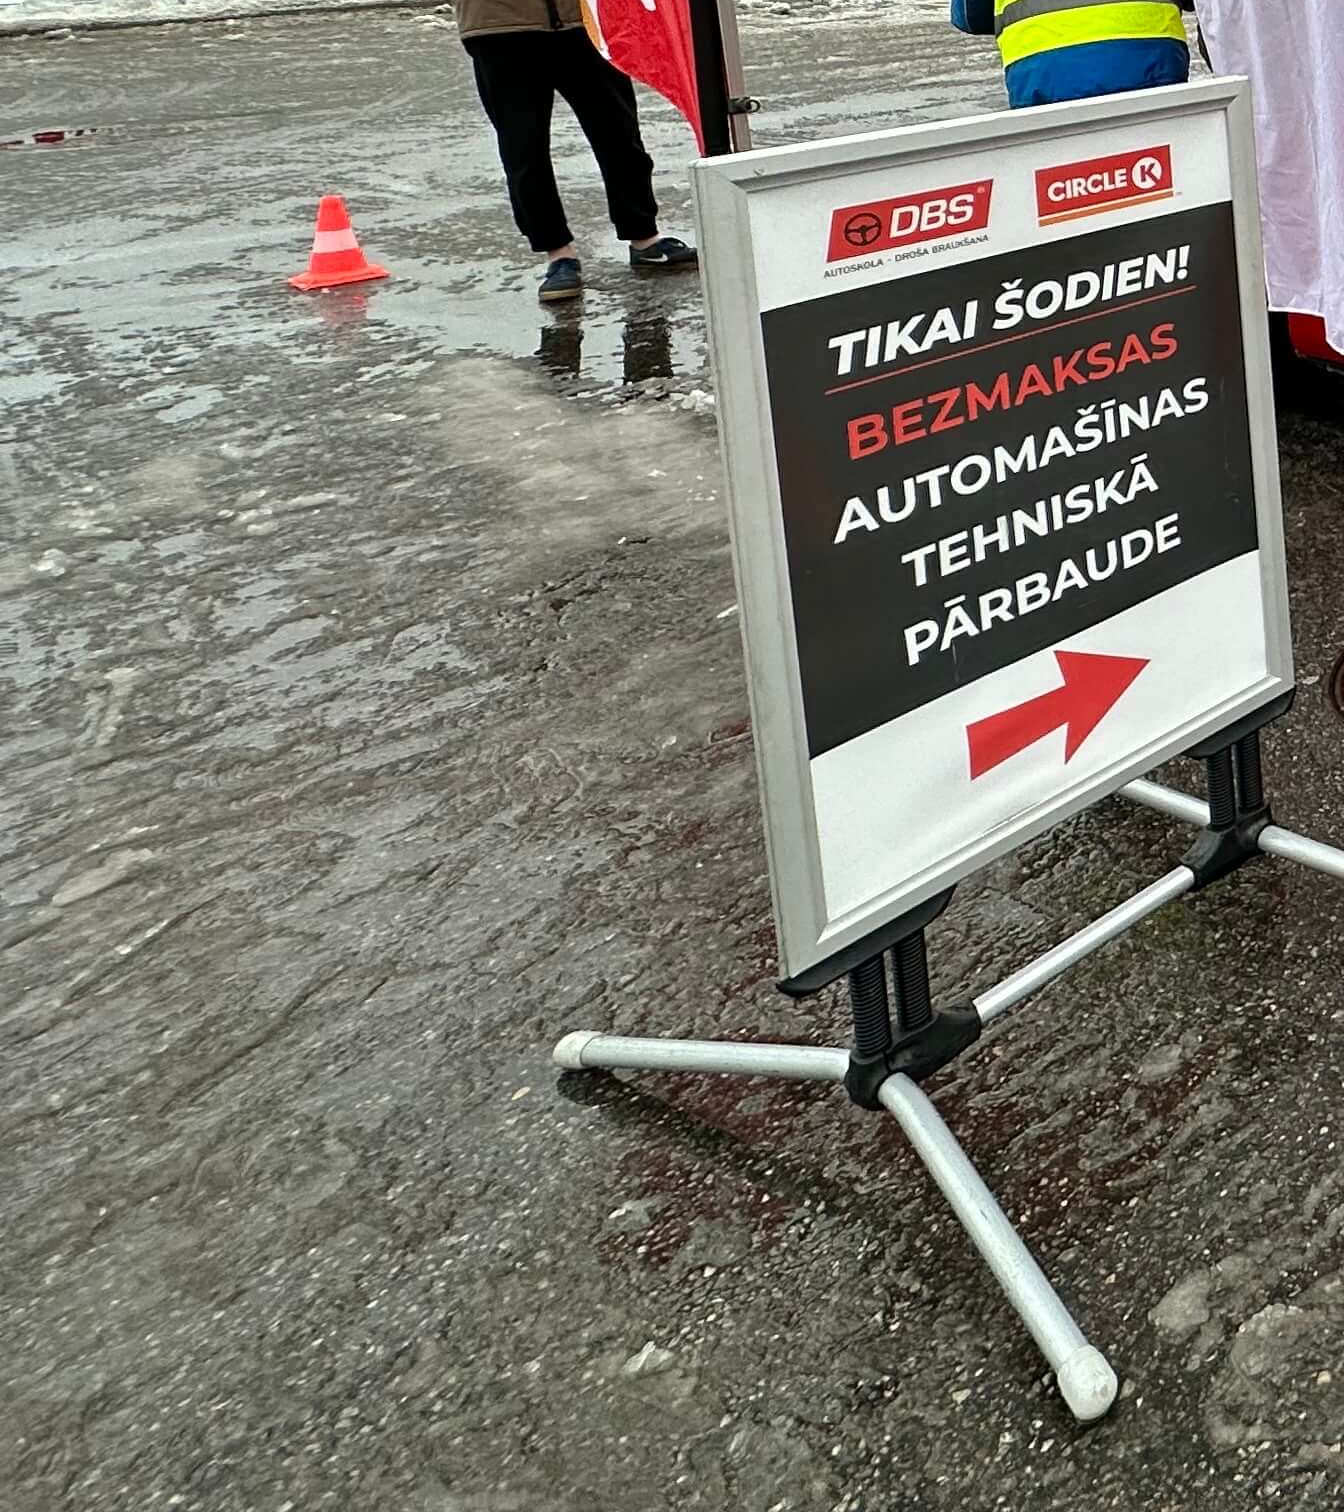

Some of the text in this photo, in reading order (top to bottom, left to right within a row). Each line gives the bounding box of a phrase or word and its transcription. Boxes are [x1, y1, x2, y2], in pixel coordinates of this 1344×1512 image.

[889, 193, 977, 239] DBS
[1047, 158, 1161, 203] CIRCLE K
[823, 234, 990, 279] AUTOSKOLA DROŠA BRAUKŠANA
[828, 244, 1192, 376] TIKAI ŠODIEN!
[847, 323, 1179, 460] BEZMAKSAS
[833, 377, 1209, 544] AUTOMAŠĪNAS
[901, 453, 1159, 587] TEHNISKĀ
[904, 513, 1182, 666] PĀRBAUDE
